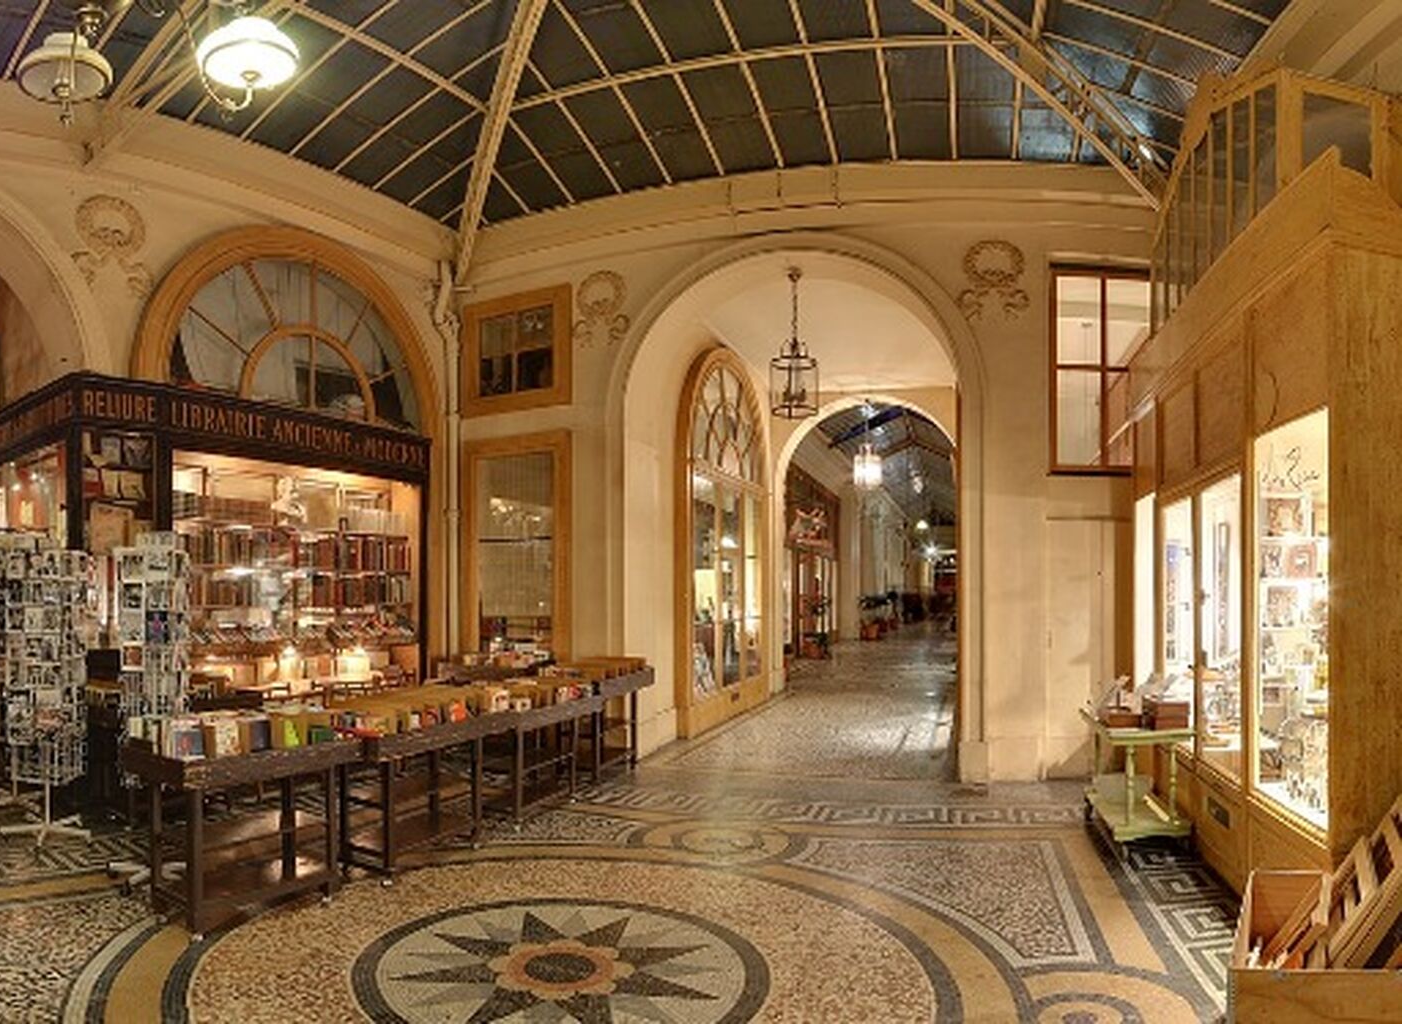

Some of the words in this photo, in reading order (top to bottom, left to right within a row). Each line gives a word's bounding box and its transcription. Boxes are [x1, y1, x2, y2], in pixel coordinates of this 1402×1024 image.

[82, 390, 157, 422] RELIURE
[171, 401, 267, 439] LIBRAIRIE
[271, 418, 351, 456] ANCIENNE
